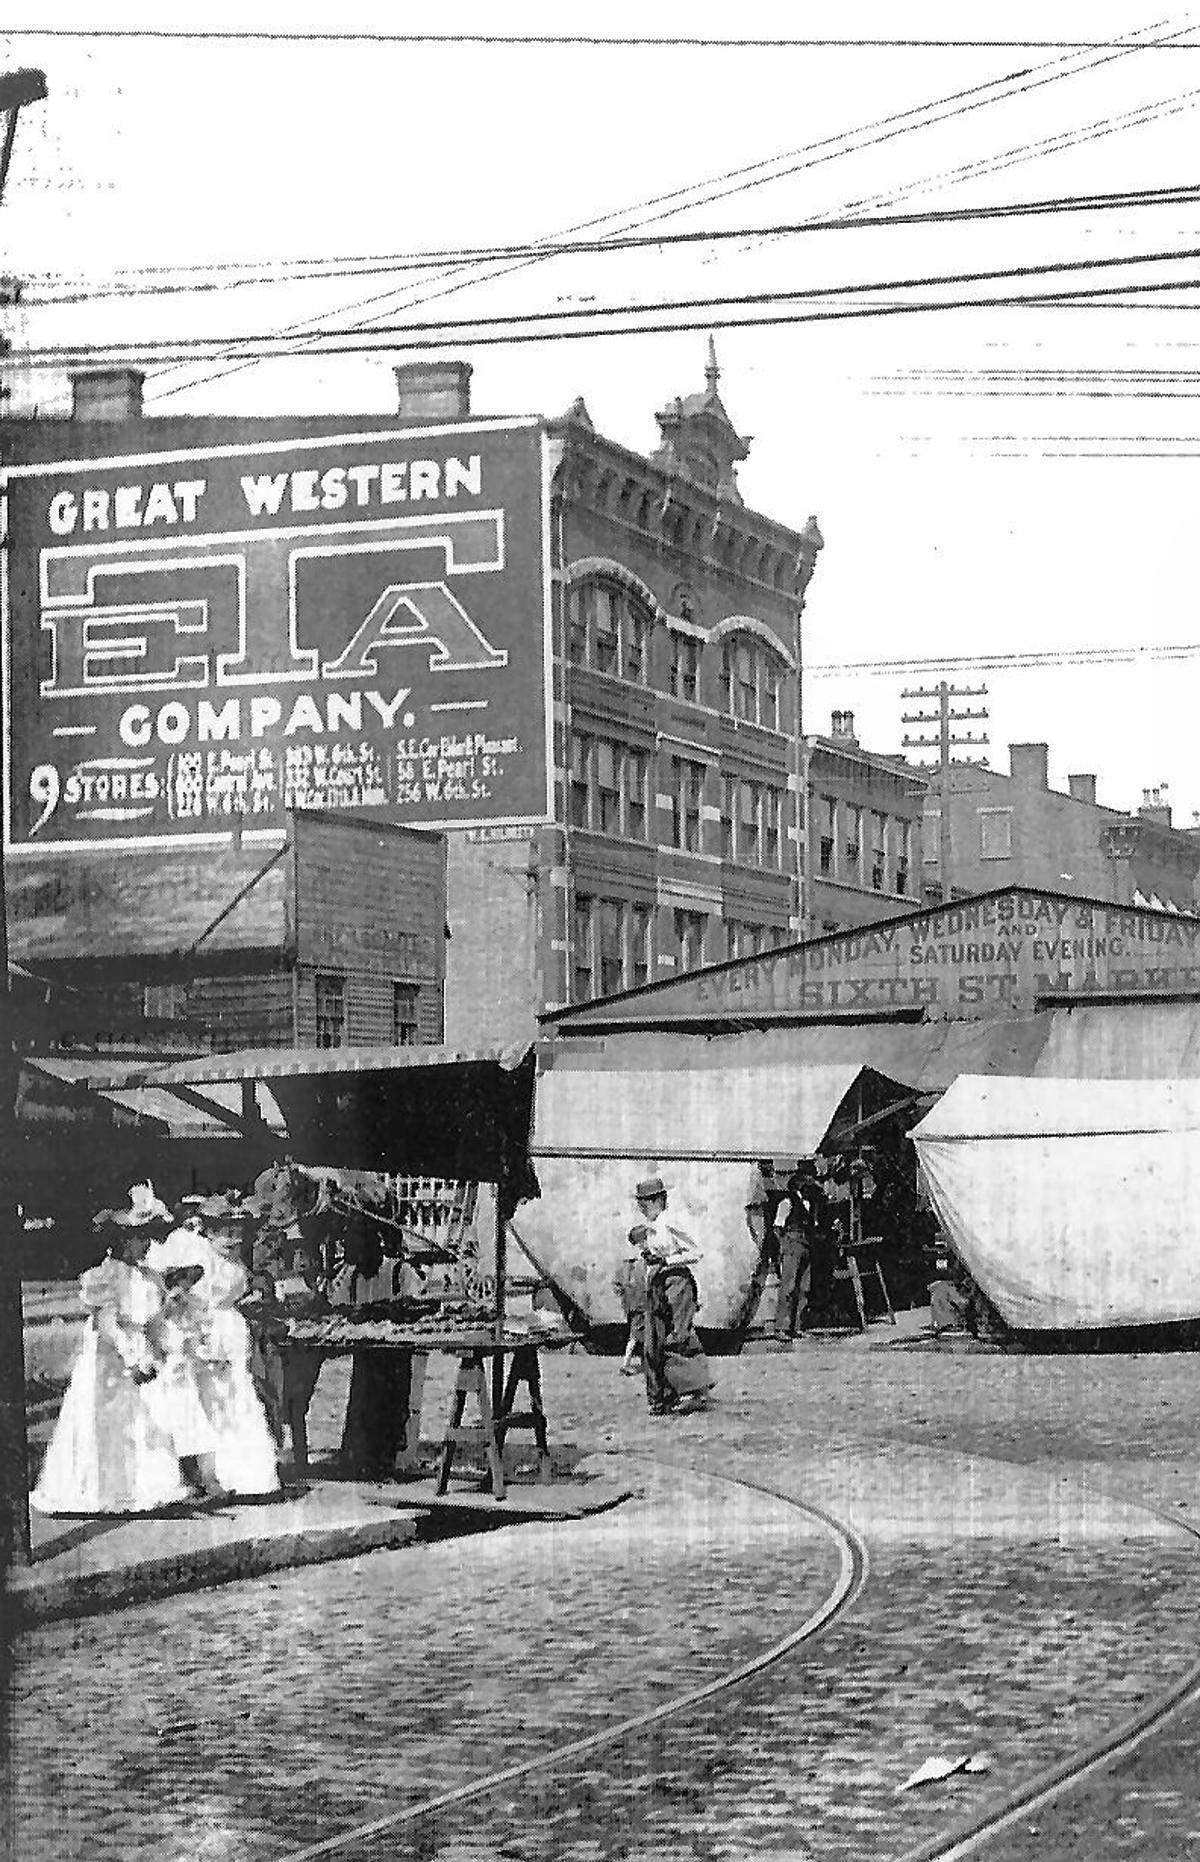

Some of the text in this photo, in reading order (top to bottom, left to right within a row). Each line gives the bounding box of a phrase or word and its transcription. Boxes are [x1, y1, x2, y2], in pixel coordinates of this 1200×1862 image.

[48, 455, 482, 535] GREAT WESTERN
[119, 688, 416, 747] COMPANY.
[438, 757, 474, 778] Pearl
[29, 764, 60, 837] 9
[697, 962, 777, 1000] EVERY
[910, 895, 1069, 943] WEDNESDAY
[1075, 904, 1089, 929] &
[1105, 911, 1199, 948] FRIDAY
[997, 923, 1037, 936] AND
[909, 940, 1024, 964] SATURDAY
[799, 977, 939, 1006] SIXTH
